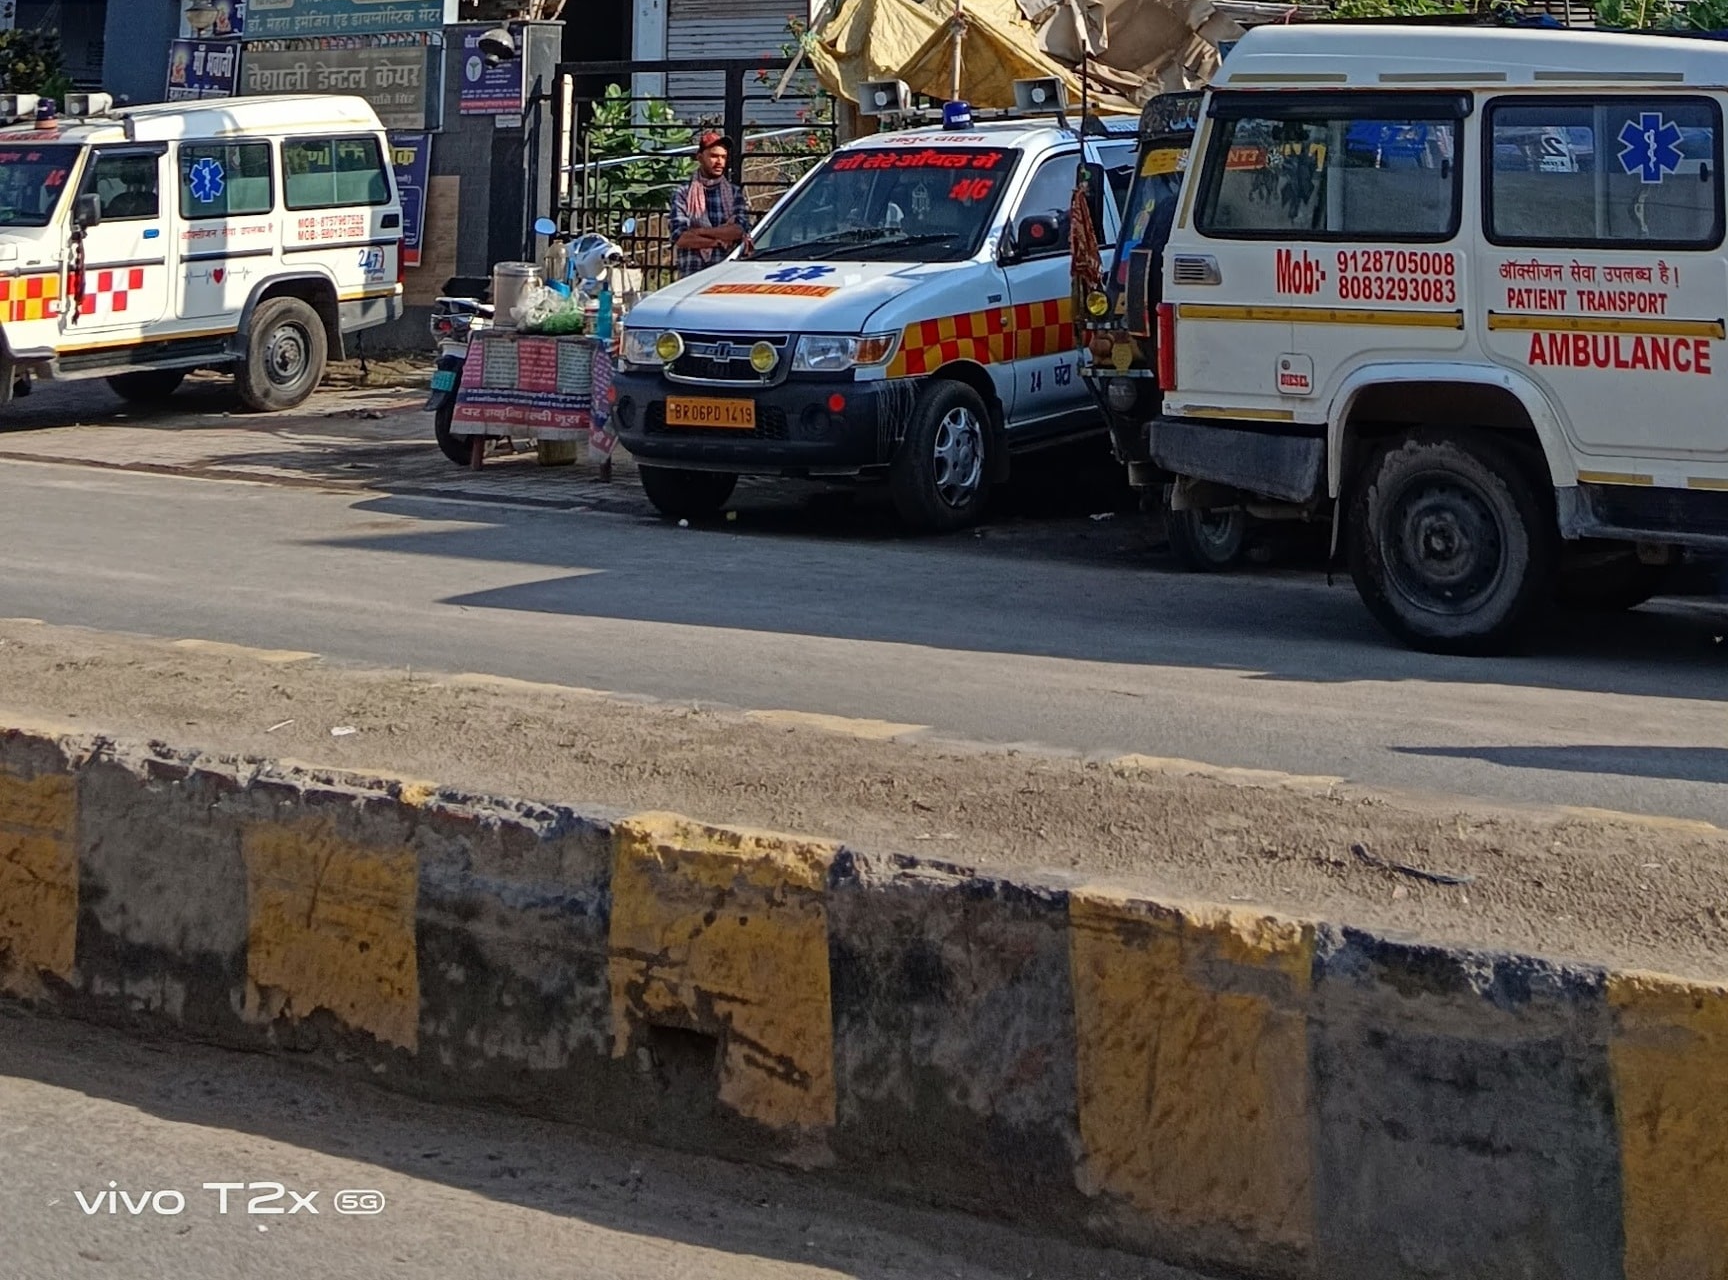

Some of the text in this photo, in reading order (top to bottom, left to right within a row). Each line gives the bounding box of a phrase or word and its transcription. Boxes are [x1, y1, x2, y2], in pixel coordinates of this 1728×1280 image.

[266, 13, 290, 30] मेहरा
[247, 59, 422, 91] वैशाली डेन्टल केयर
[1337, 250, 1455, 276] 9128705008
[1500, 258, 1564, 281] ऑक्सीजन
[1570, 259, 1597, 282] सेवा
[1603, 266, 1653, 284] उपलब्ध
[1339, 275, 1456, 303] 8083293083
[1507, 288, 1668, 314] PATIENT TRANSPORT
[1529, 332, 1712, 374] AMBULANCE
[1030, 370, 1042, 393] 24
[1280, 373, 1310, 388] DIESEL
[725, 406, 752, 424] 1419
